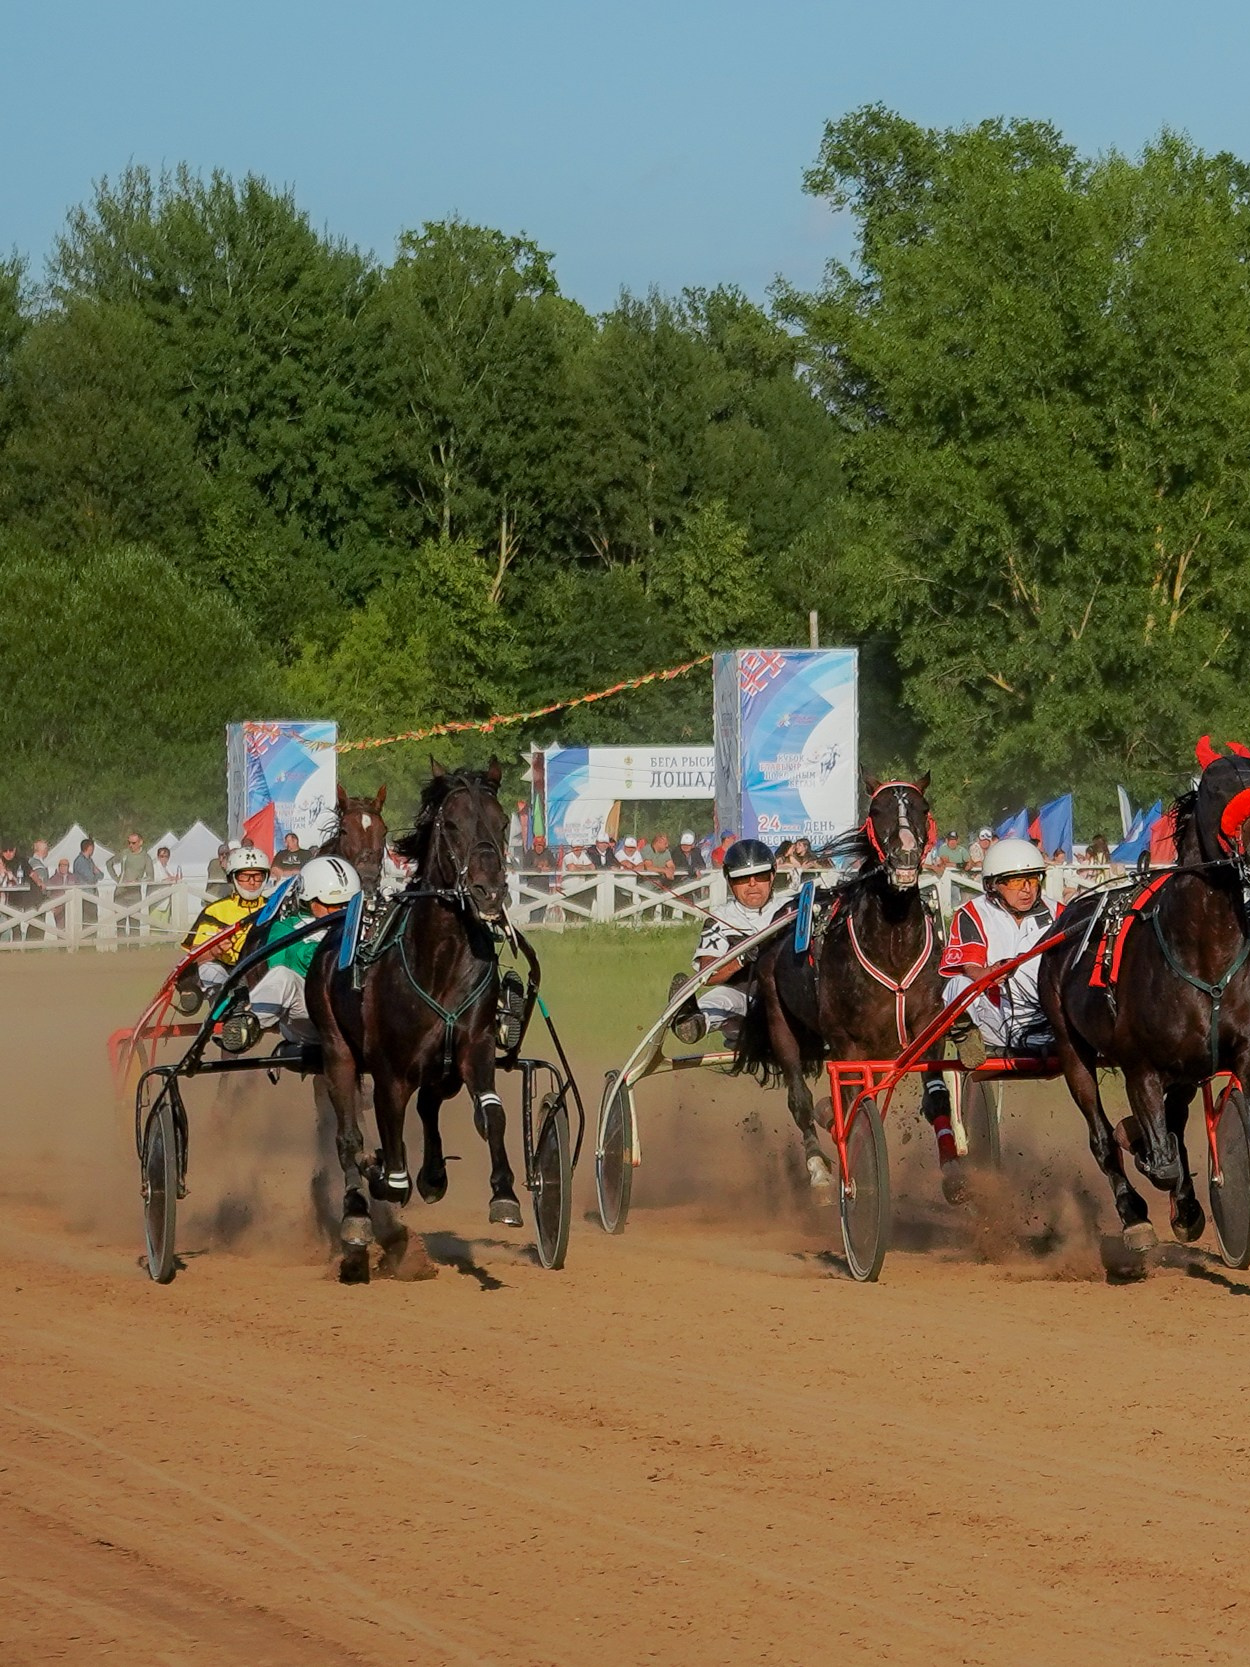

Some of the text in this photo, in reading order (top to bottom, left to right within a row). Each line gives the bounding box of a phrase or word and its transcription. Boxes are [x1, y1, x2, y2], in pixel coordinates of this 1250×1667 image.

[650, 756, 678, 768] БЕГА
[759, 816, 780, 830] 24
[804, 821, 835, 833] ДЕНЬ
